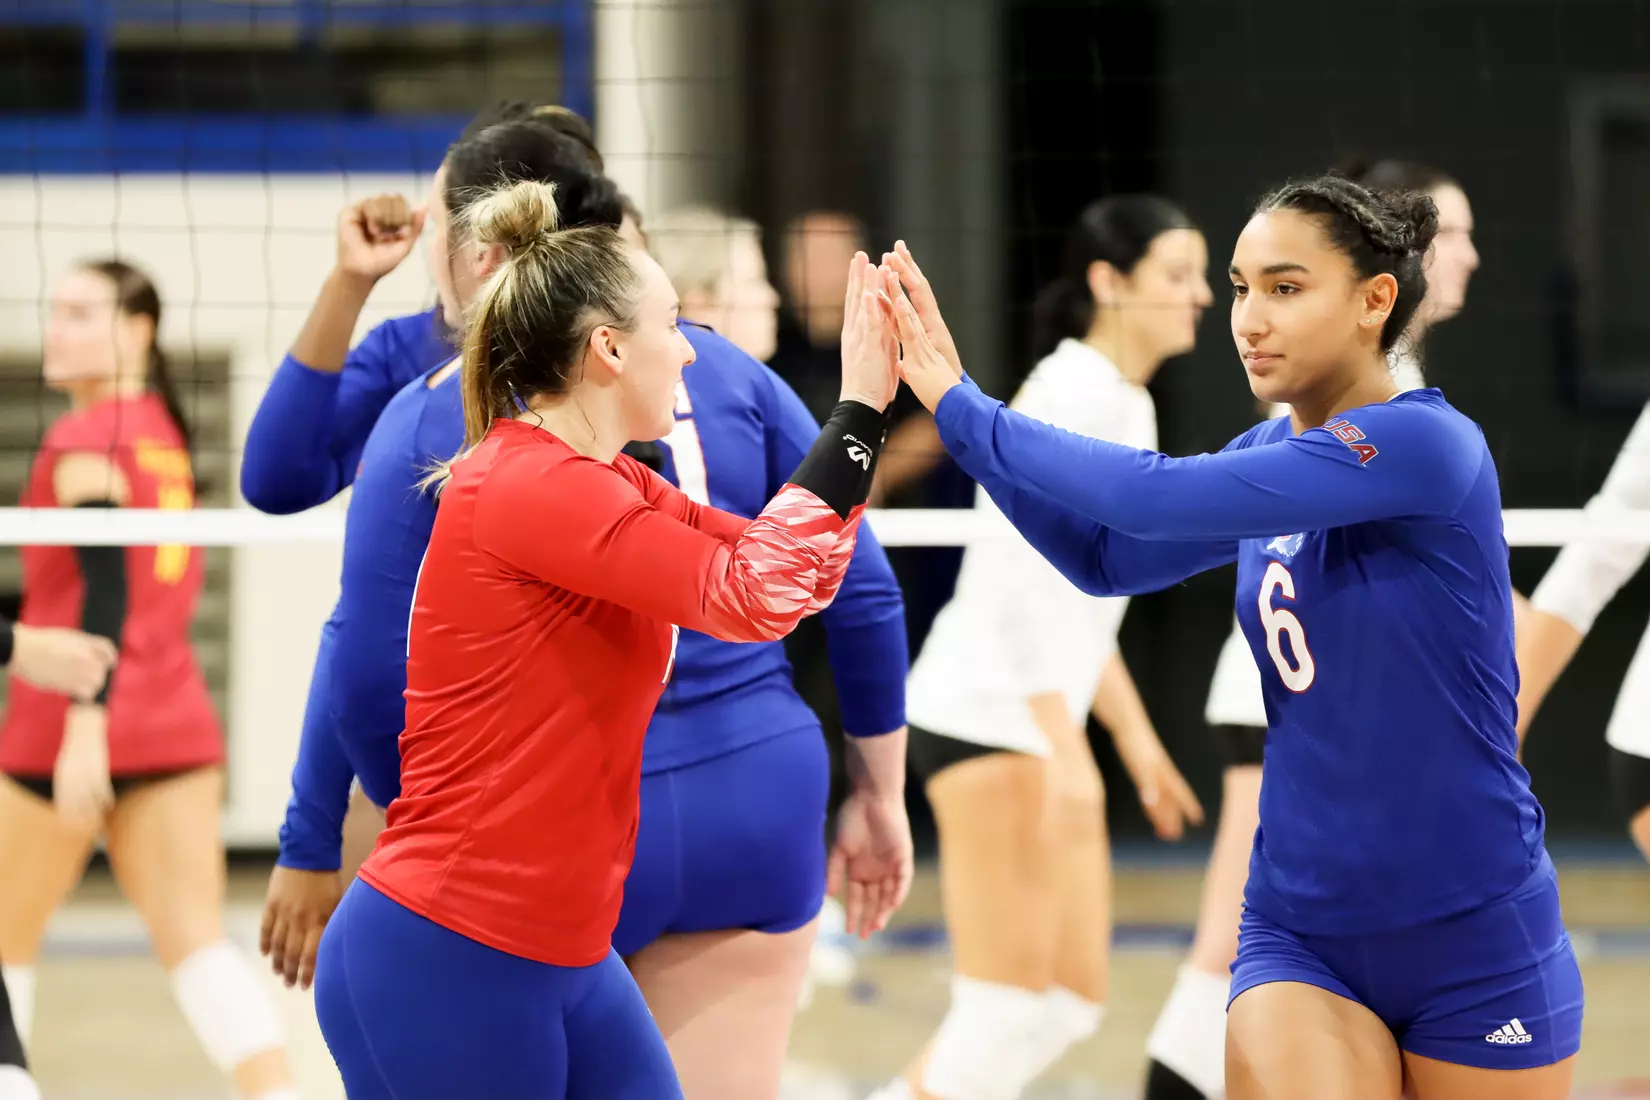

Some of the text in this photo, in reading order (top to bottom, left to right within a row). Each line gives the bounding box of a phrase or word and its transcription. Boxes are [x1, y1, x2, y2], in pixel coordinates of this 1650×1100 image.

[1321, 417, 1379, 465] USA
[1258, 560, 1316, 694] 6
[1485, 1034, 1533, 1044] adidas
